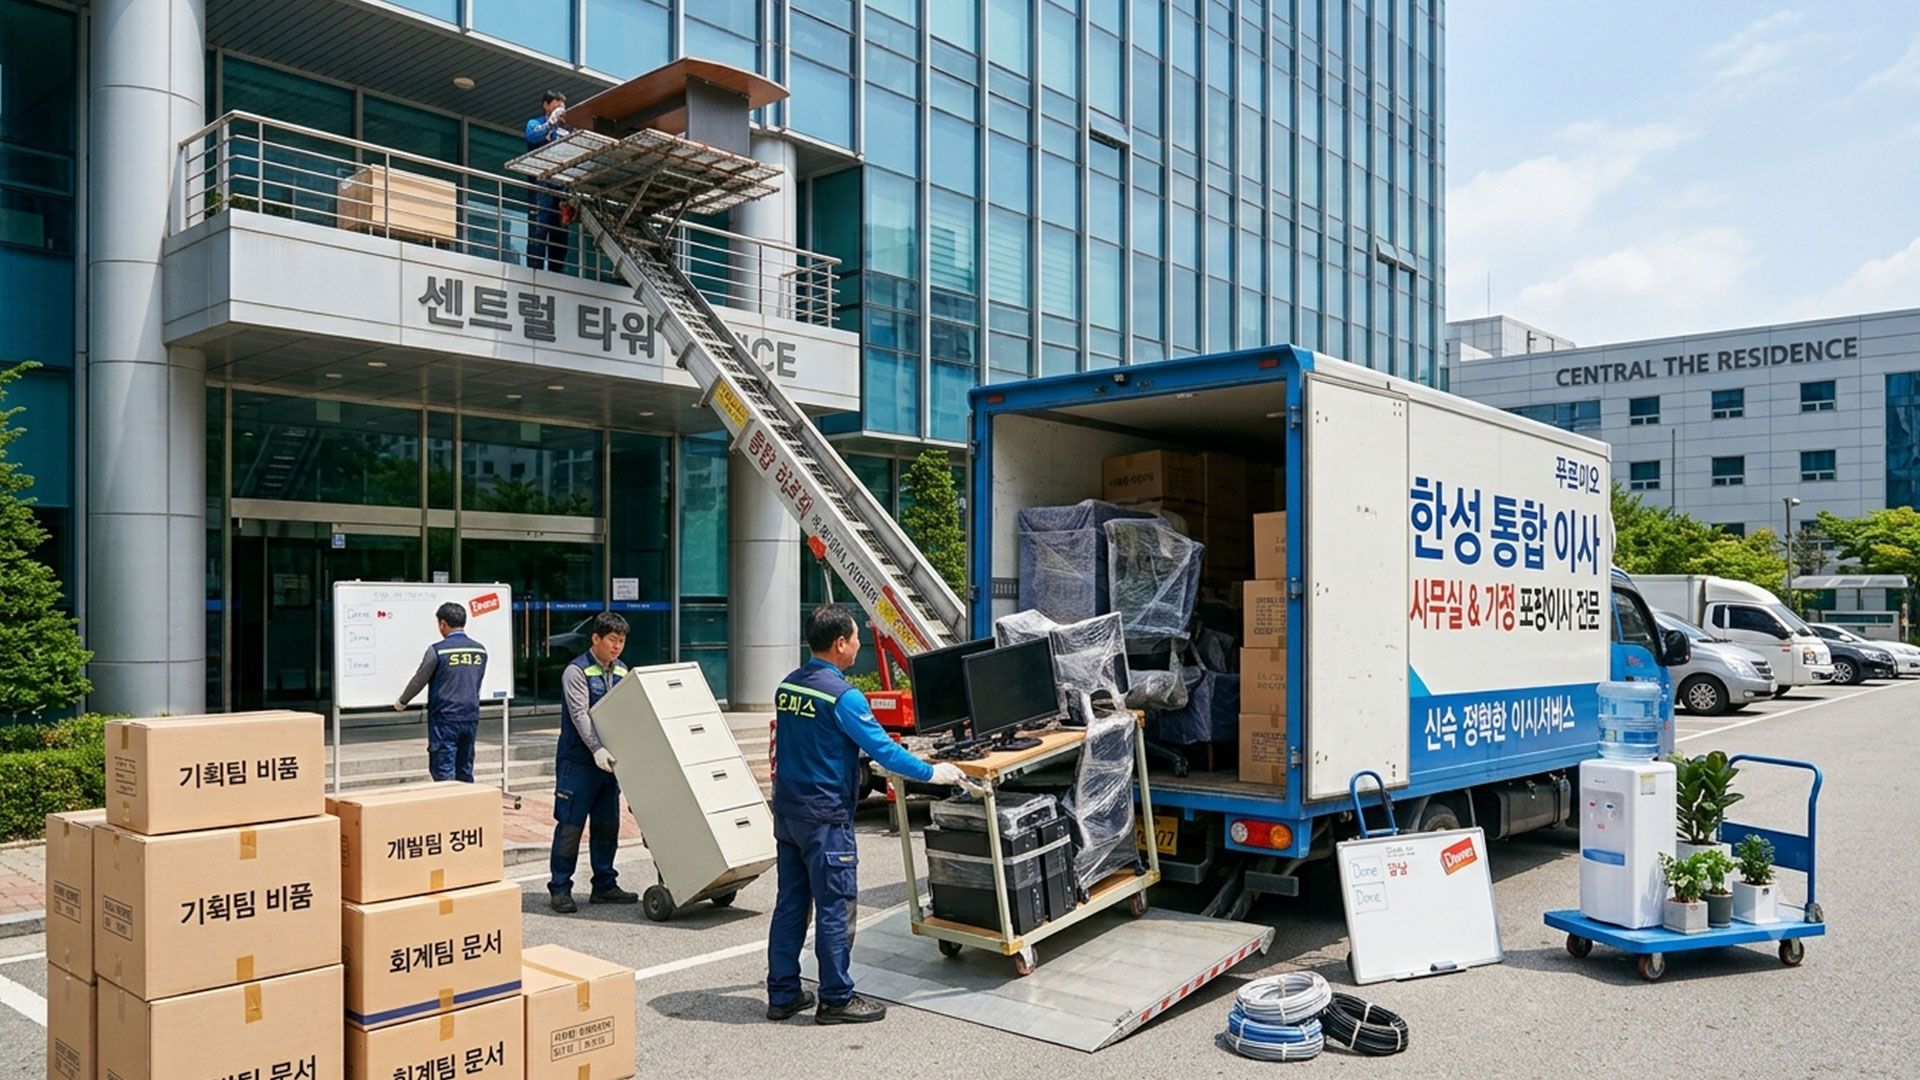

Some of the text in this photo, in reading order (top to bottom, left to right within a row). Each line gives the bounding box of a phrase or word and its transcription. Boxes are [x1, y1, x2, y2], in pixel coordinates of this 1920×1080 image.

[418, 275, 556, 343] 센트럴
[577, 303, 655, 359] 타워
[1555, 336, 1858, 387] CENTRAL THE RESIDENCE
[1410, 476, 1600, 575] 한성 통합 이사
[1410, 578, 1463, 630] 사무실
[1467, 583, 1481, 627] &
[256, 756, 299, 782] 비품
[449, 827, 483, 852] 장비
[1353, 863, 1378, 879] Done
[266, 882, 313, 912] 비품
[389, 938, 454, 973] 회계팀
[461, 929, 502, 961] 문서
[464, 1040, 504, 1075] 문서
